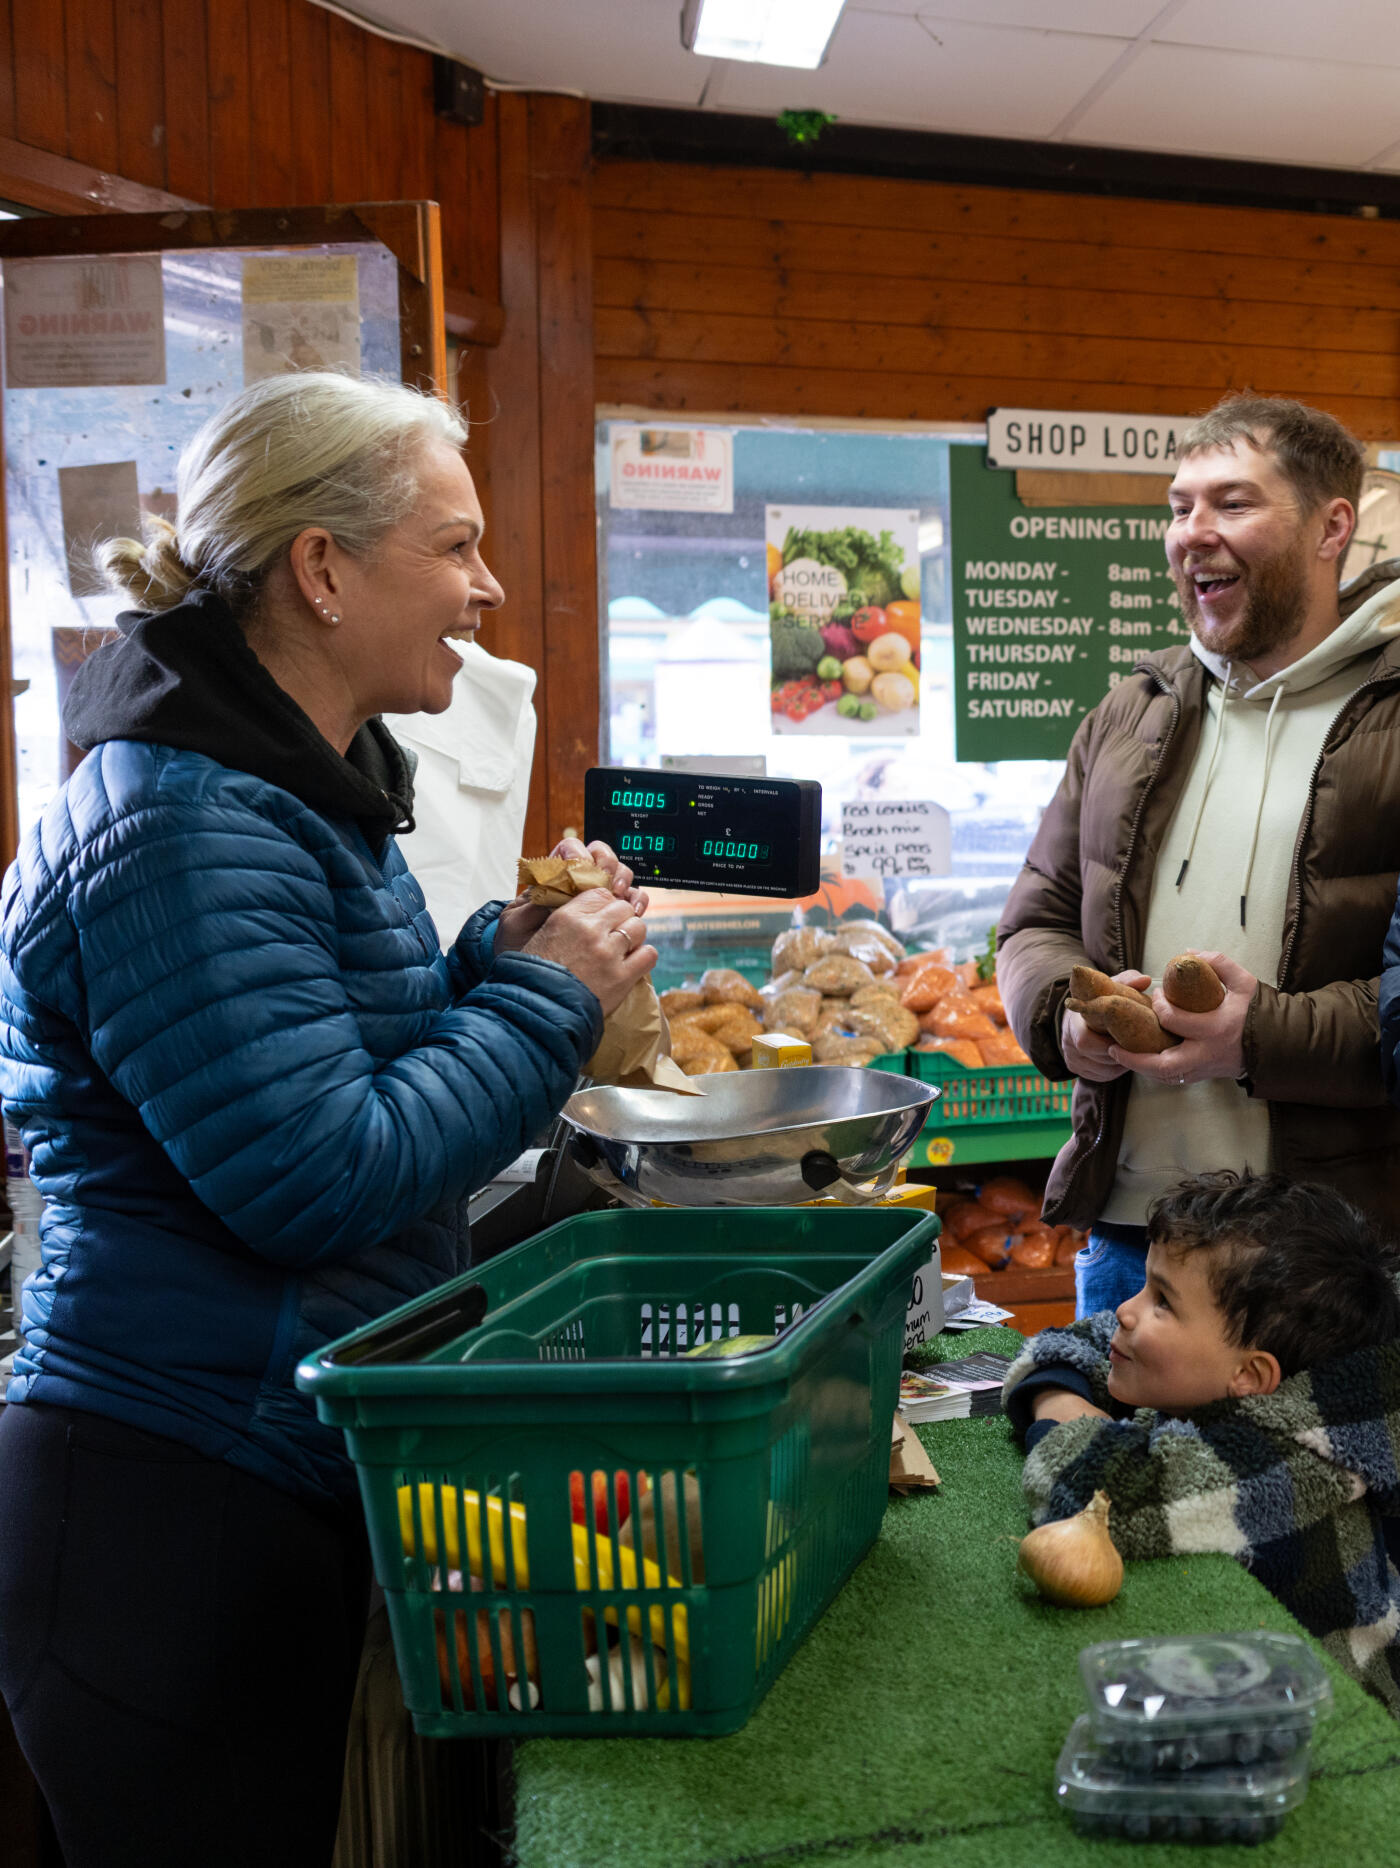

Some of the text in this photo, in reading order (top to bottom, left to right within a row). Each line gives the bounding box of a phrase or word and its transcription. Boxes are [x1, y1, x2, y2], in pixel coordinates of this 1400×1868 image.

[1006, 421, 1178, 462] SHOP LOCA
[1009, 515, 1168, 541] OPENING TIM
[782, 570, 840, 588] HOME
[964, 561, 1058, 582] MONDAY
[1107, 563, 1151, 582] 8am
[782, 591, 875, 609] DELIVERY
[964, 588, 1059, 609] TUESDAY
[1109, 590, 1152, 609] 8am
[965, 616, 1094, 636] WEDNESDAY
[1108, 617, 1151, 637] 8am
[965, 643, 1076, 664] THURSDAY
[967, 671, 1041, 691] FRIDAY
[967, 698, 1075, 719] SATURDAY
